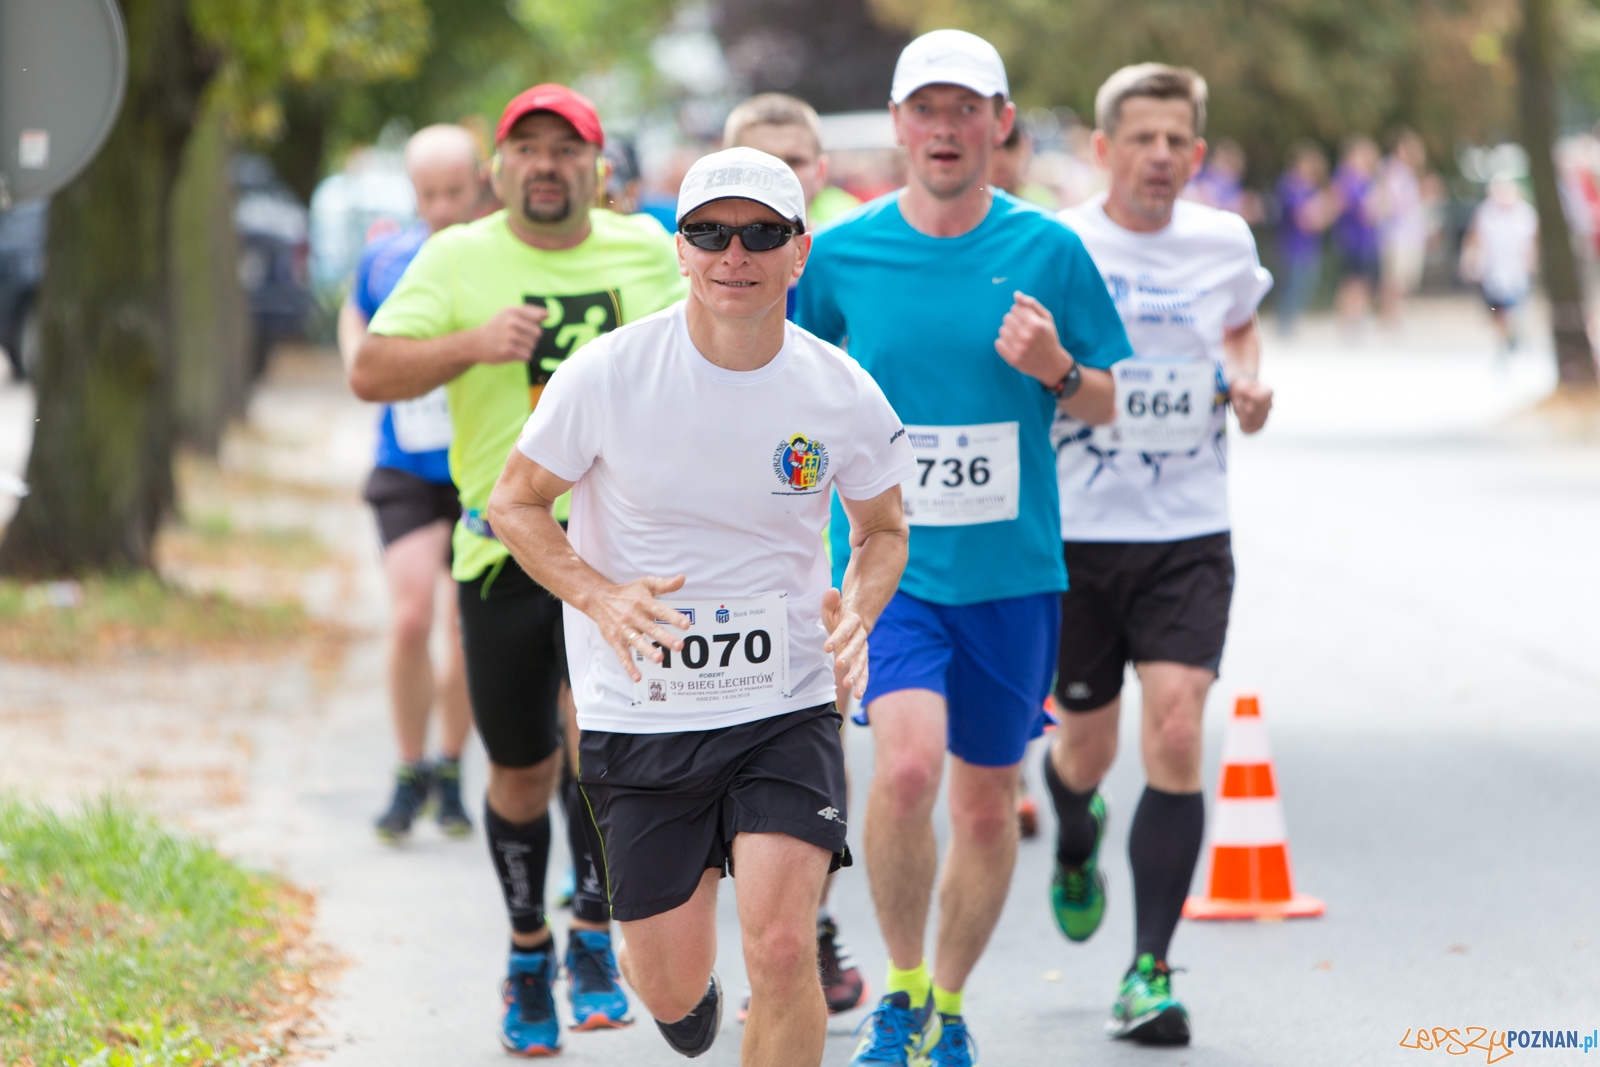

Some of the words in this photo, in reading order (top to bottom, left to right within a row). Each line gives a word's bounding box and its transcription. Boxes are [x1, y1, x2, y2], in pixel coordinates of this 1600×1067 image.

[1127, 390, 1190, 417] 664
[916, 457, 990, 487] 736
[749, 608, 766, 616] Polski
[652, 629, 771, 669] 1070
[670, 681, 684, 691] 39
[688, 680, 715, 690] BIEG
[718, 672, 774, 688] LECHITÓW
[817, 806, 839, 820] 4F
